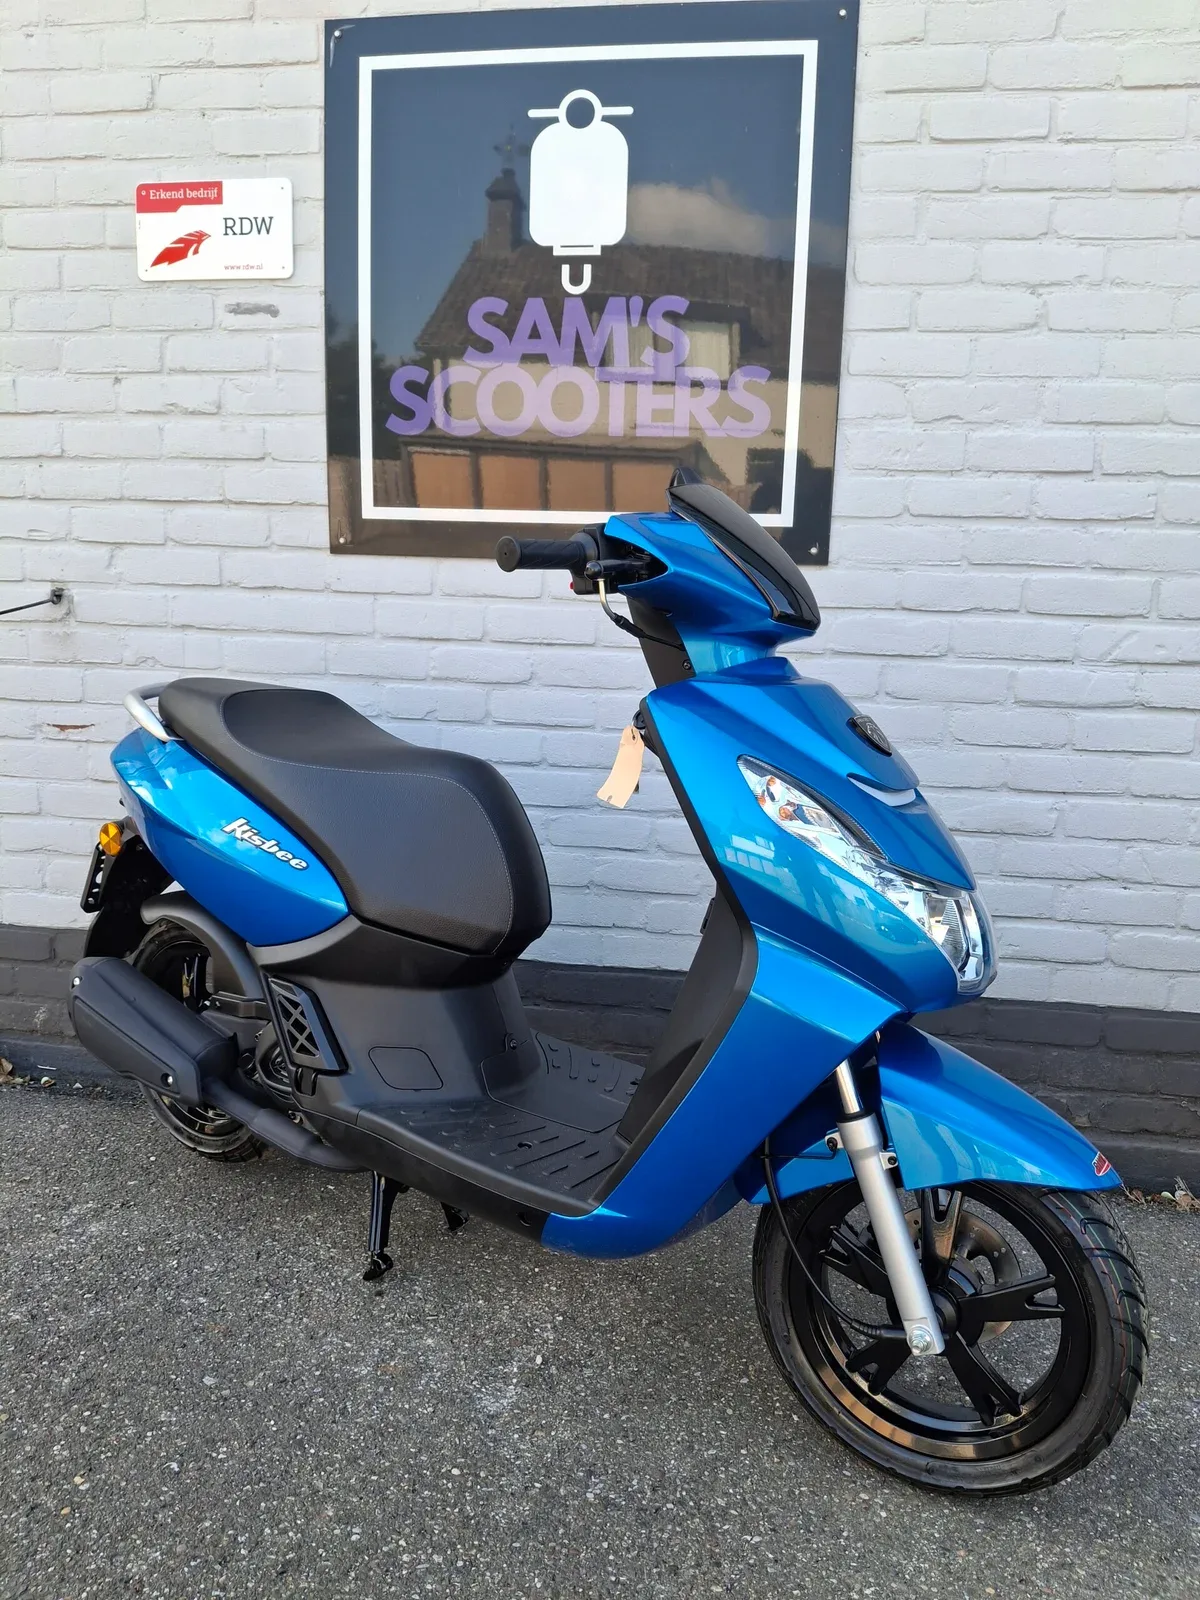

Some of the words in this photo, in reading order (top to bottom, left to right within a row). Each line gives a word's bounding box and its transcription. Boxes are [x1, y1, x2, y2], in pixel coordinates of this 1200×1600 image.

[149, 188, 184, 200] Erkend
[186, 187, 218, 200] bedrijf
[223, 216, 274, 236] RDW
[224, 263, 263, 271] www.rdw.nl
[463, 295, 690, 368] SAM'S
[385, 365, 771, 439] SCOOTERS
[221, 817, 308, 870] Kisbee
